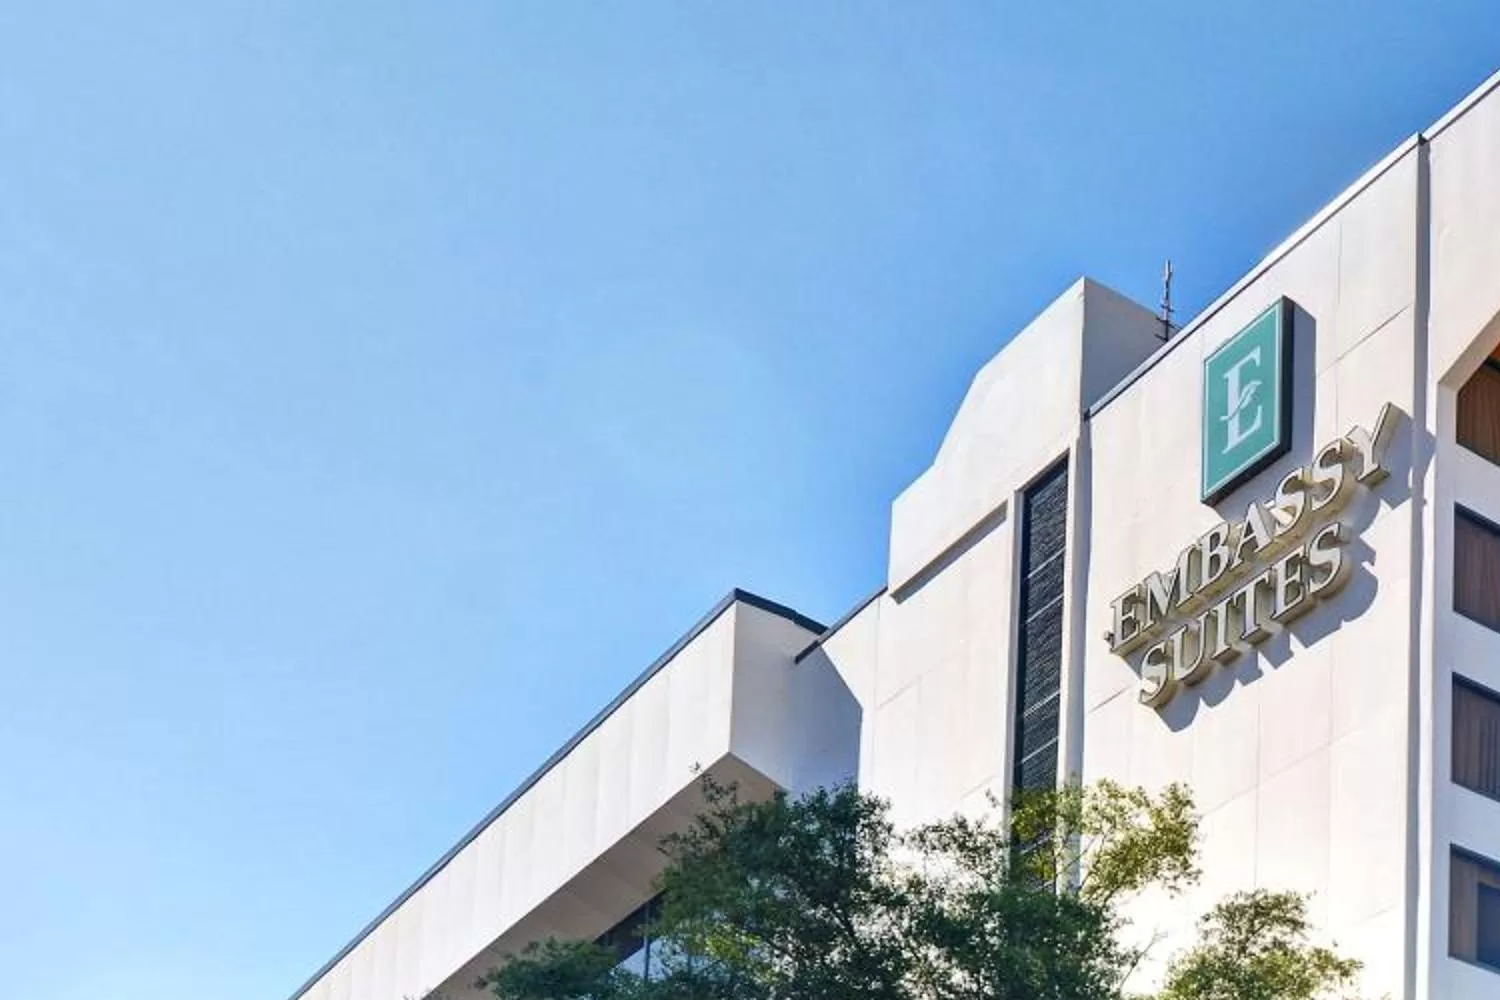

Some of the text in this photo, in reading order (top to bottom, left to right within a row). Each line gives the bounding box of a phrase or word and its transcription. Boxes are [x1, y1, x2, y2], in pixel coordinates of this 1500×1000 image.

[1220, 345, 1264, 455] E
[1104, 401, 1398, 653] EMBASSY
[1138, 521, 1348, 706] SUITES
